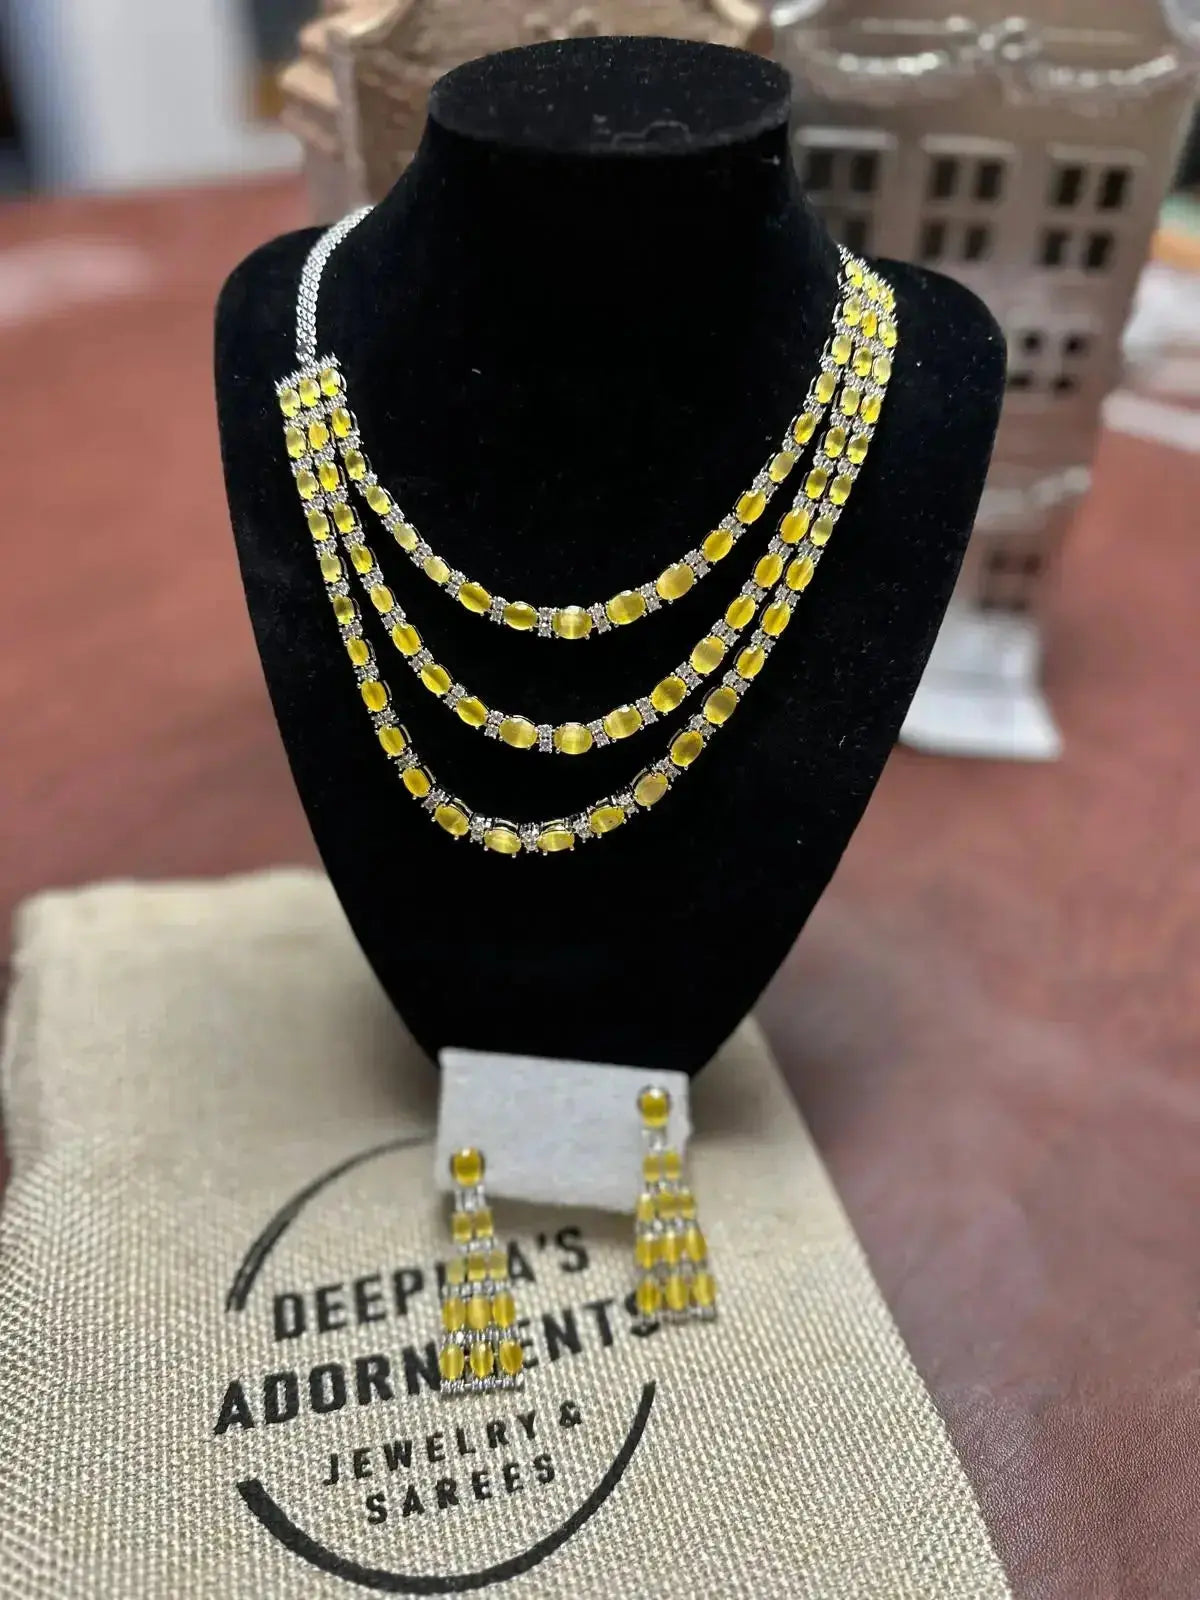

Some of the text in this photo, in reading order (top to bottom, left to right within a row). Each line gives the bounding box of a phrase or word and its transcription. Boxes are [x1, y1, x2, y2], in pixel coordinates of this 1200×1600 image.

[273, 1226, 588, 1341] DEEPIA'S
[214, 1289, 660, 1434] ADORNENTS
[323, 1400, 582, 1485] JEWELRY &
[365, 1453, 555, 1524] SAREES
